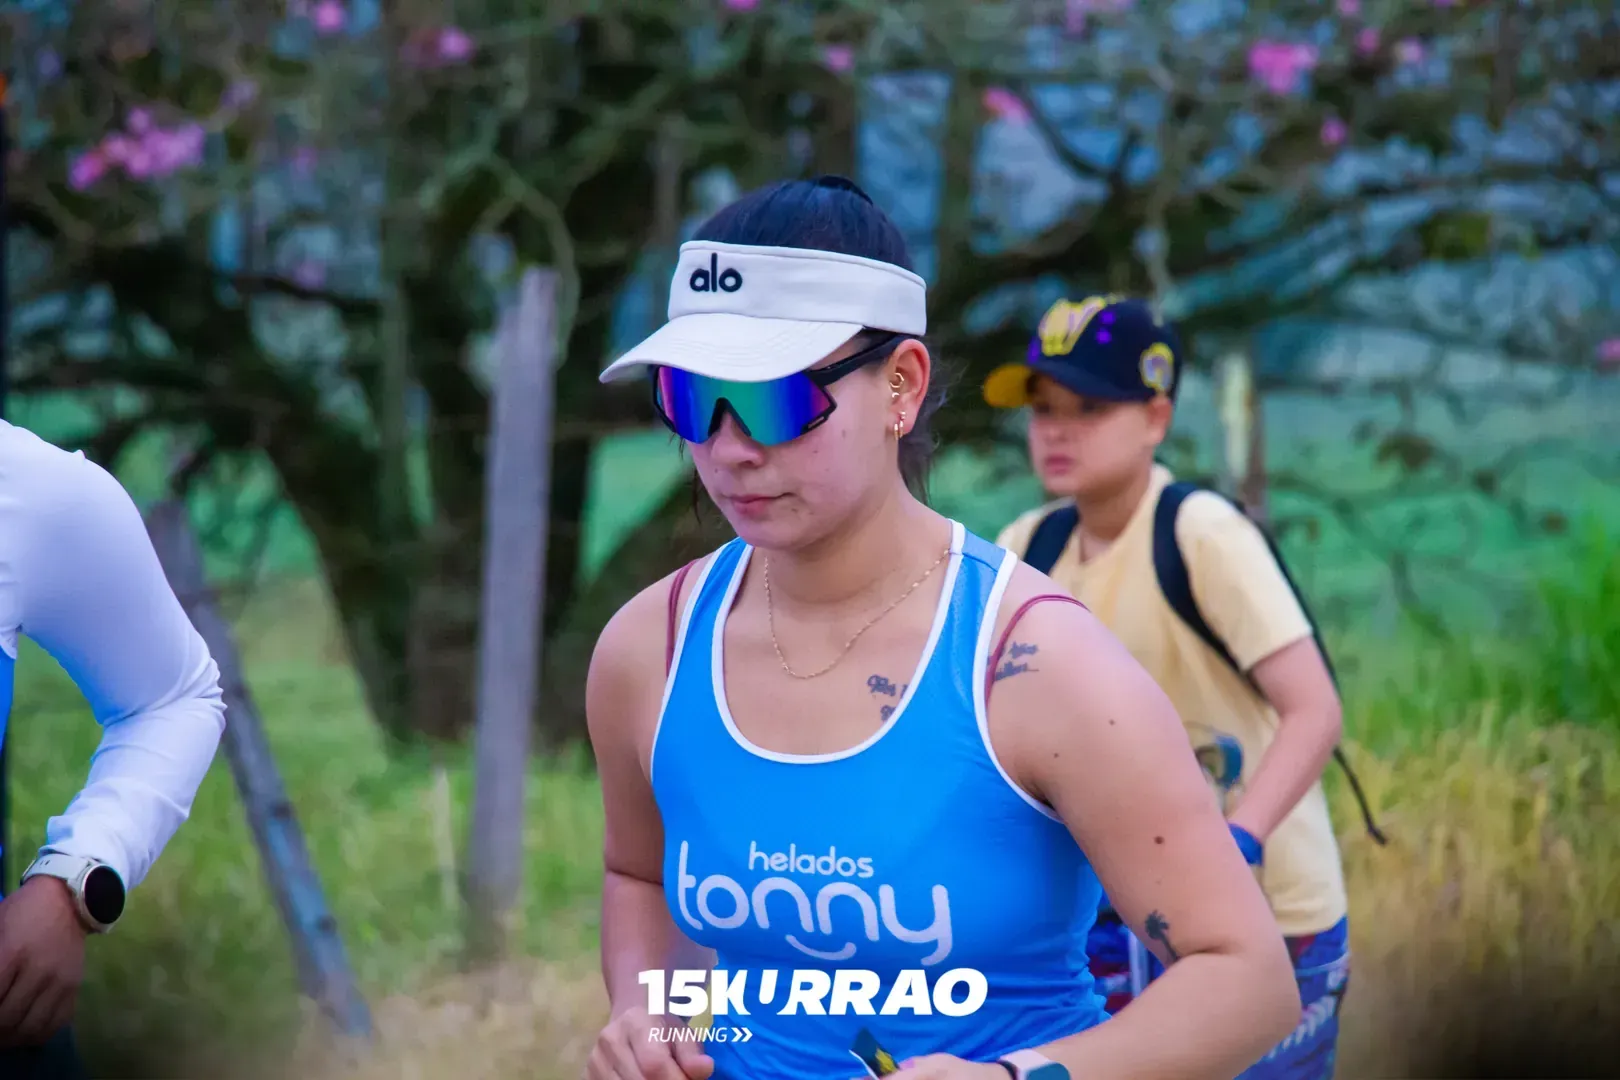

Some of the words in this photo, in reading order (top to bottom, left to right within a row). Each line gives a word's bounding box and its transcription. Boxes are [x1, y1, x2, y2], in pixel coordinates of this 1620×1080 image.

[689, 252, 743, 293] alo
[748, 840, 873, 878] helados
[677, 840, 952, 966] tonny
